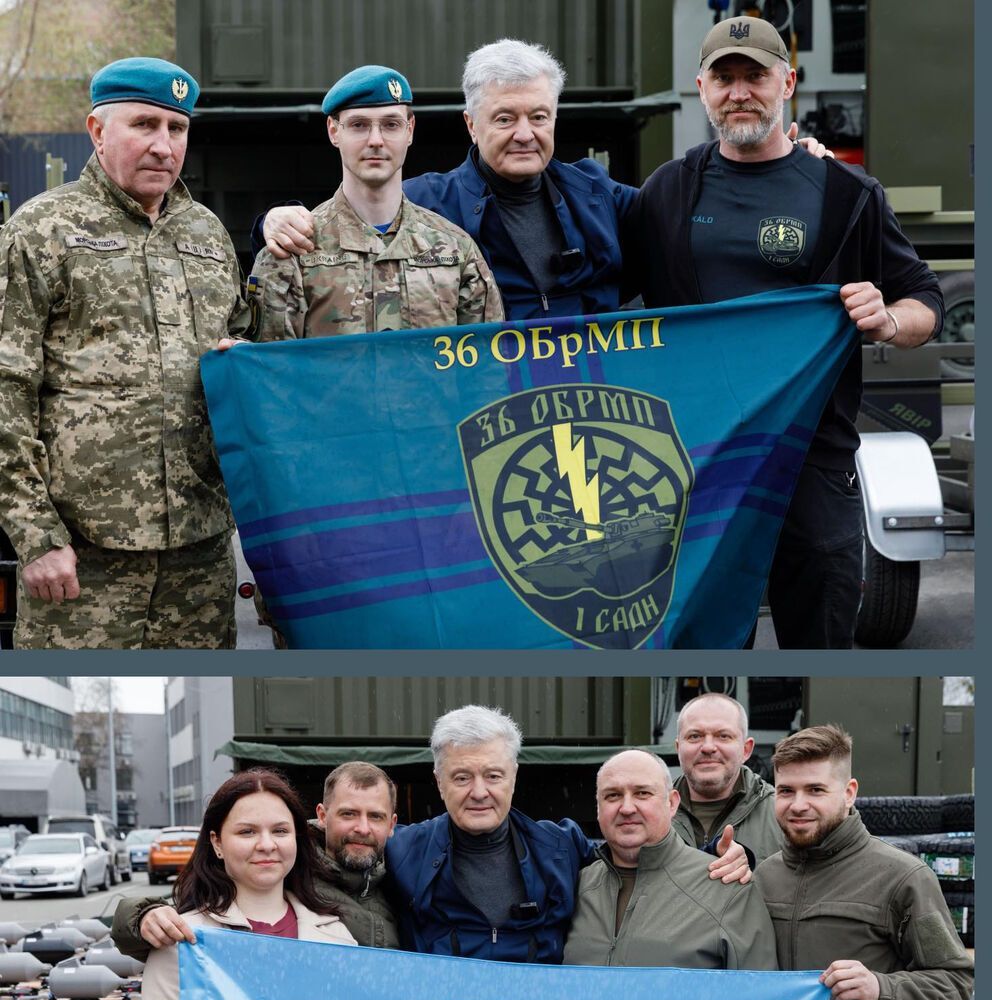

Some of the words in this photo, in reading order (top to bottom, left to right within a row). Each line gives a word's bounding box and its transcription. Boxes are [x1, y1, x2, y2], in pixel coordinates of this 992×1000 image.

[433, 332, 479, 370] 36
[490, 316, 665, 368] ОБрМП
[475, 405, 517, 447] 36
[530, 389, 656, 427] ОБРМП
[595, 593, 660, 632] САДН
